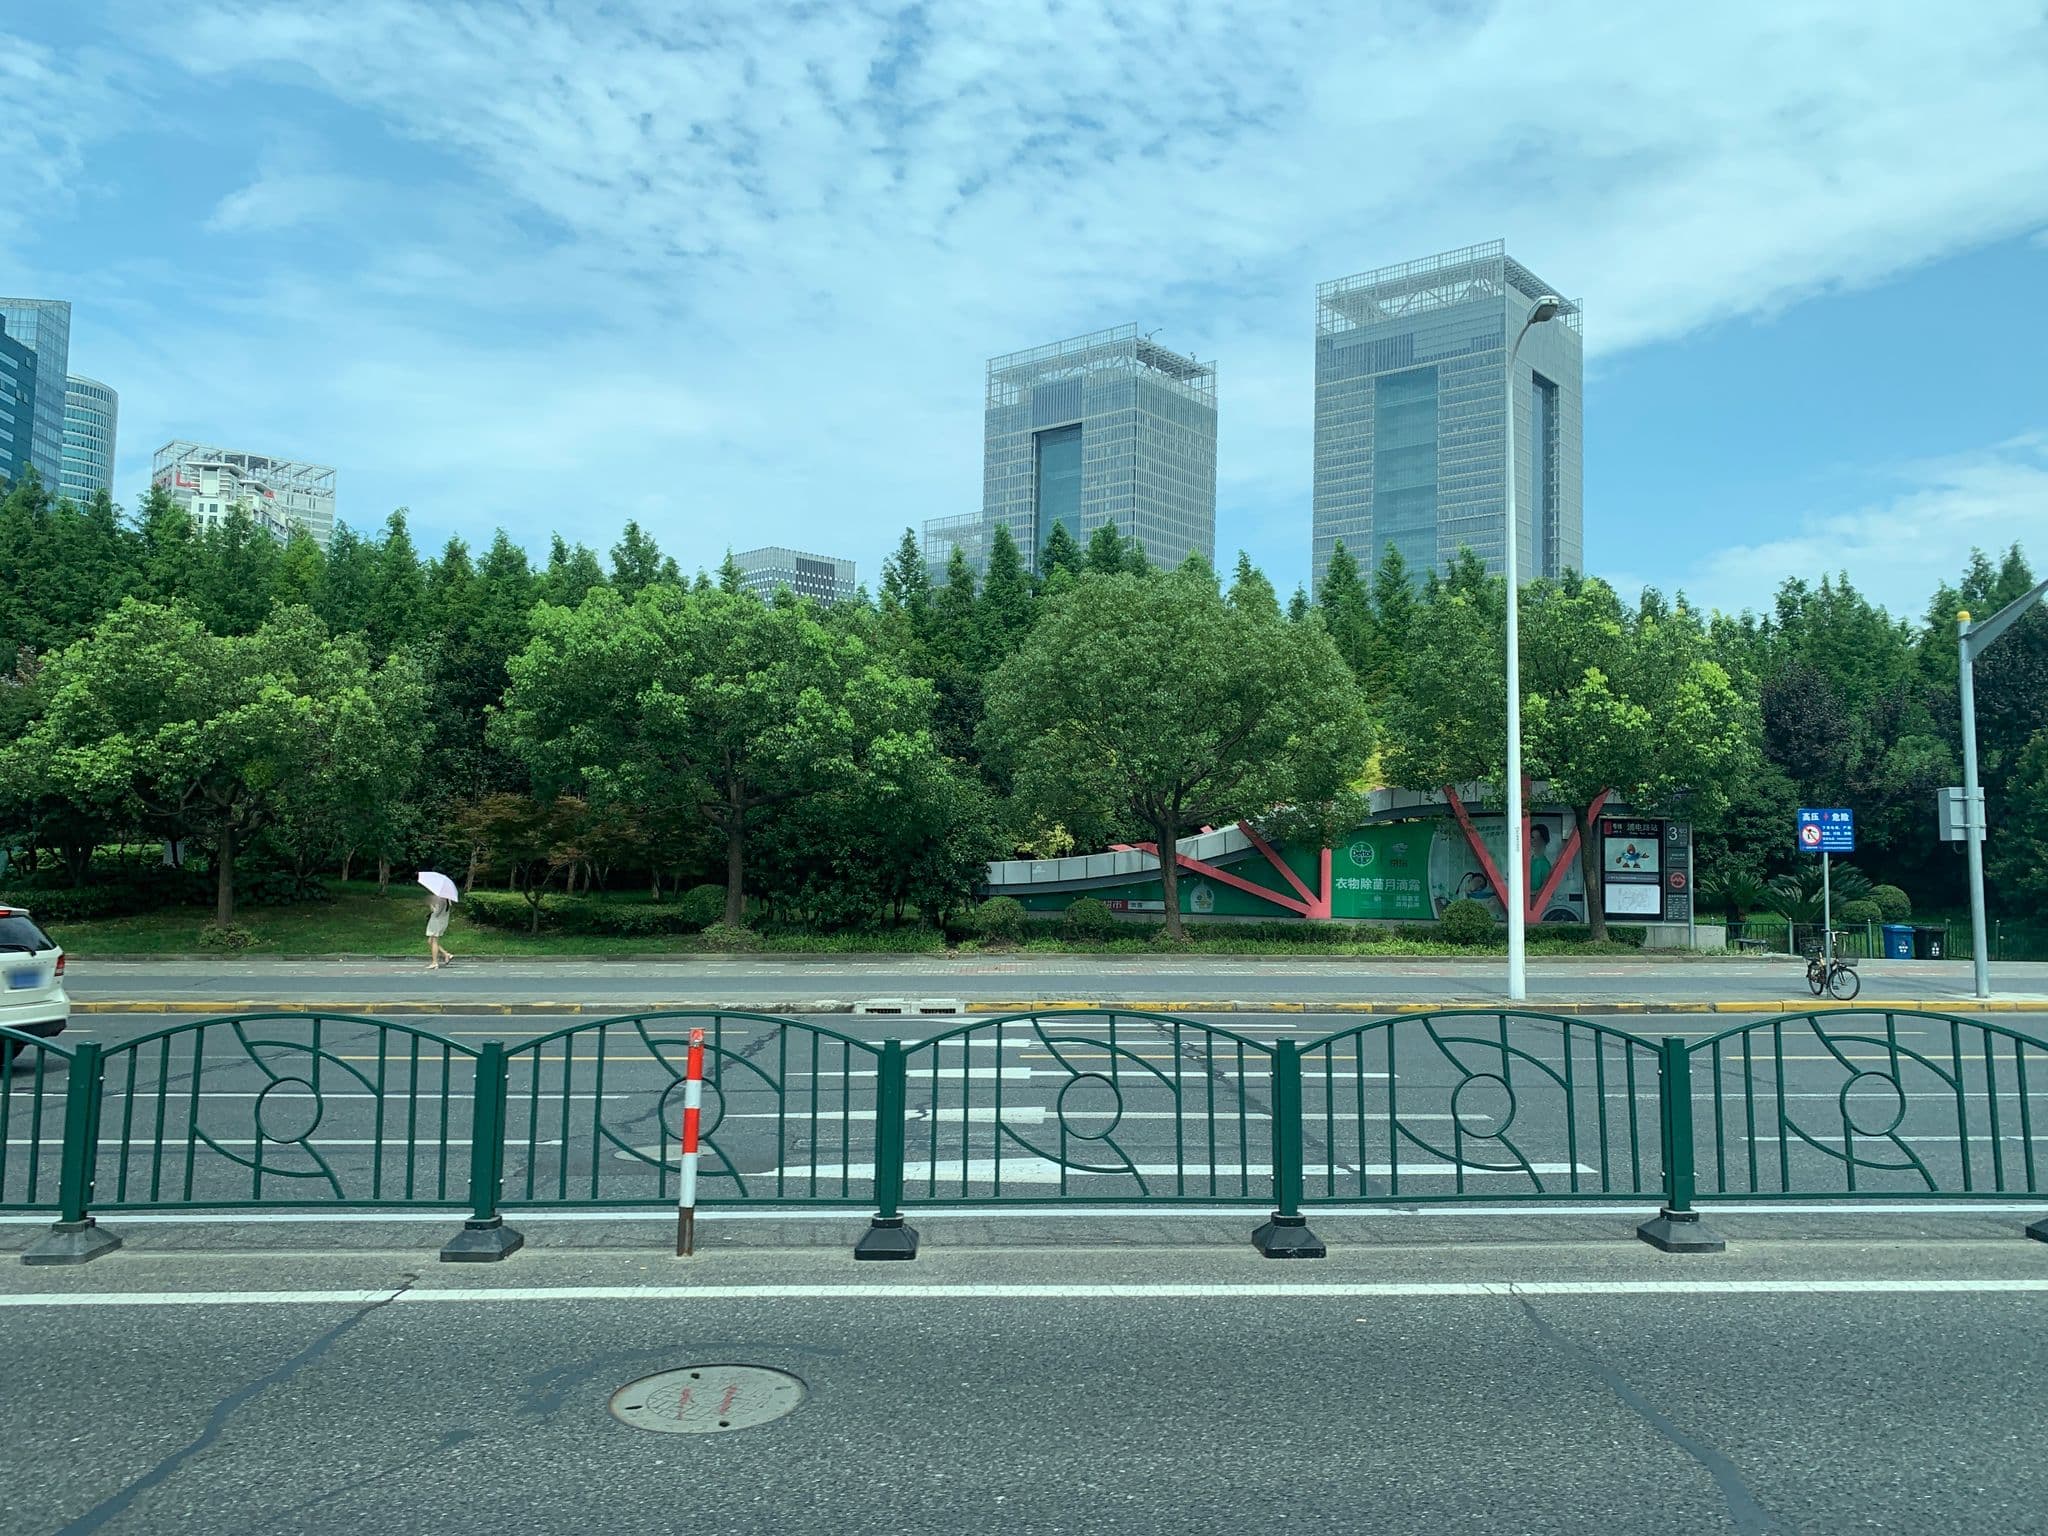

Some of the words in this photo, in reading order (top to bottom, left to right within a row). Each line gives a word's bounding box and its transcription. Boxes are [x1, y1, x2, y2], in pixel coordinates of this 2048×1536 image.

[1802, 812, 1820, 821] 高压
[1832, 812, 1850, 821] 危险
[1669, 826, 1678, 841] 3
[1352, 850, 1372, 858] Dettol
